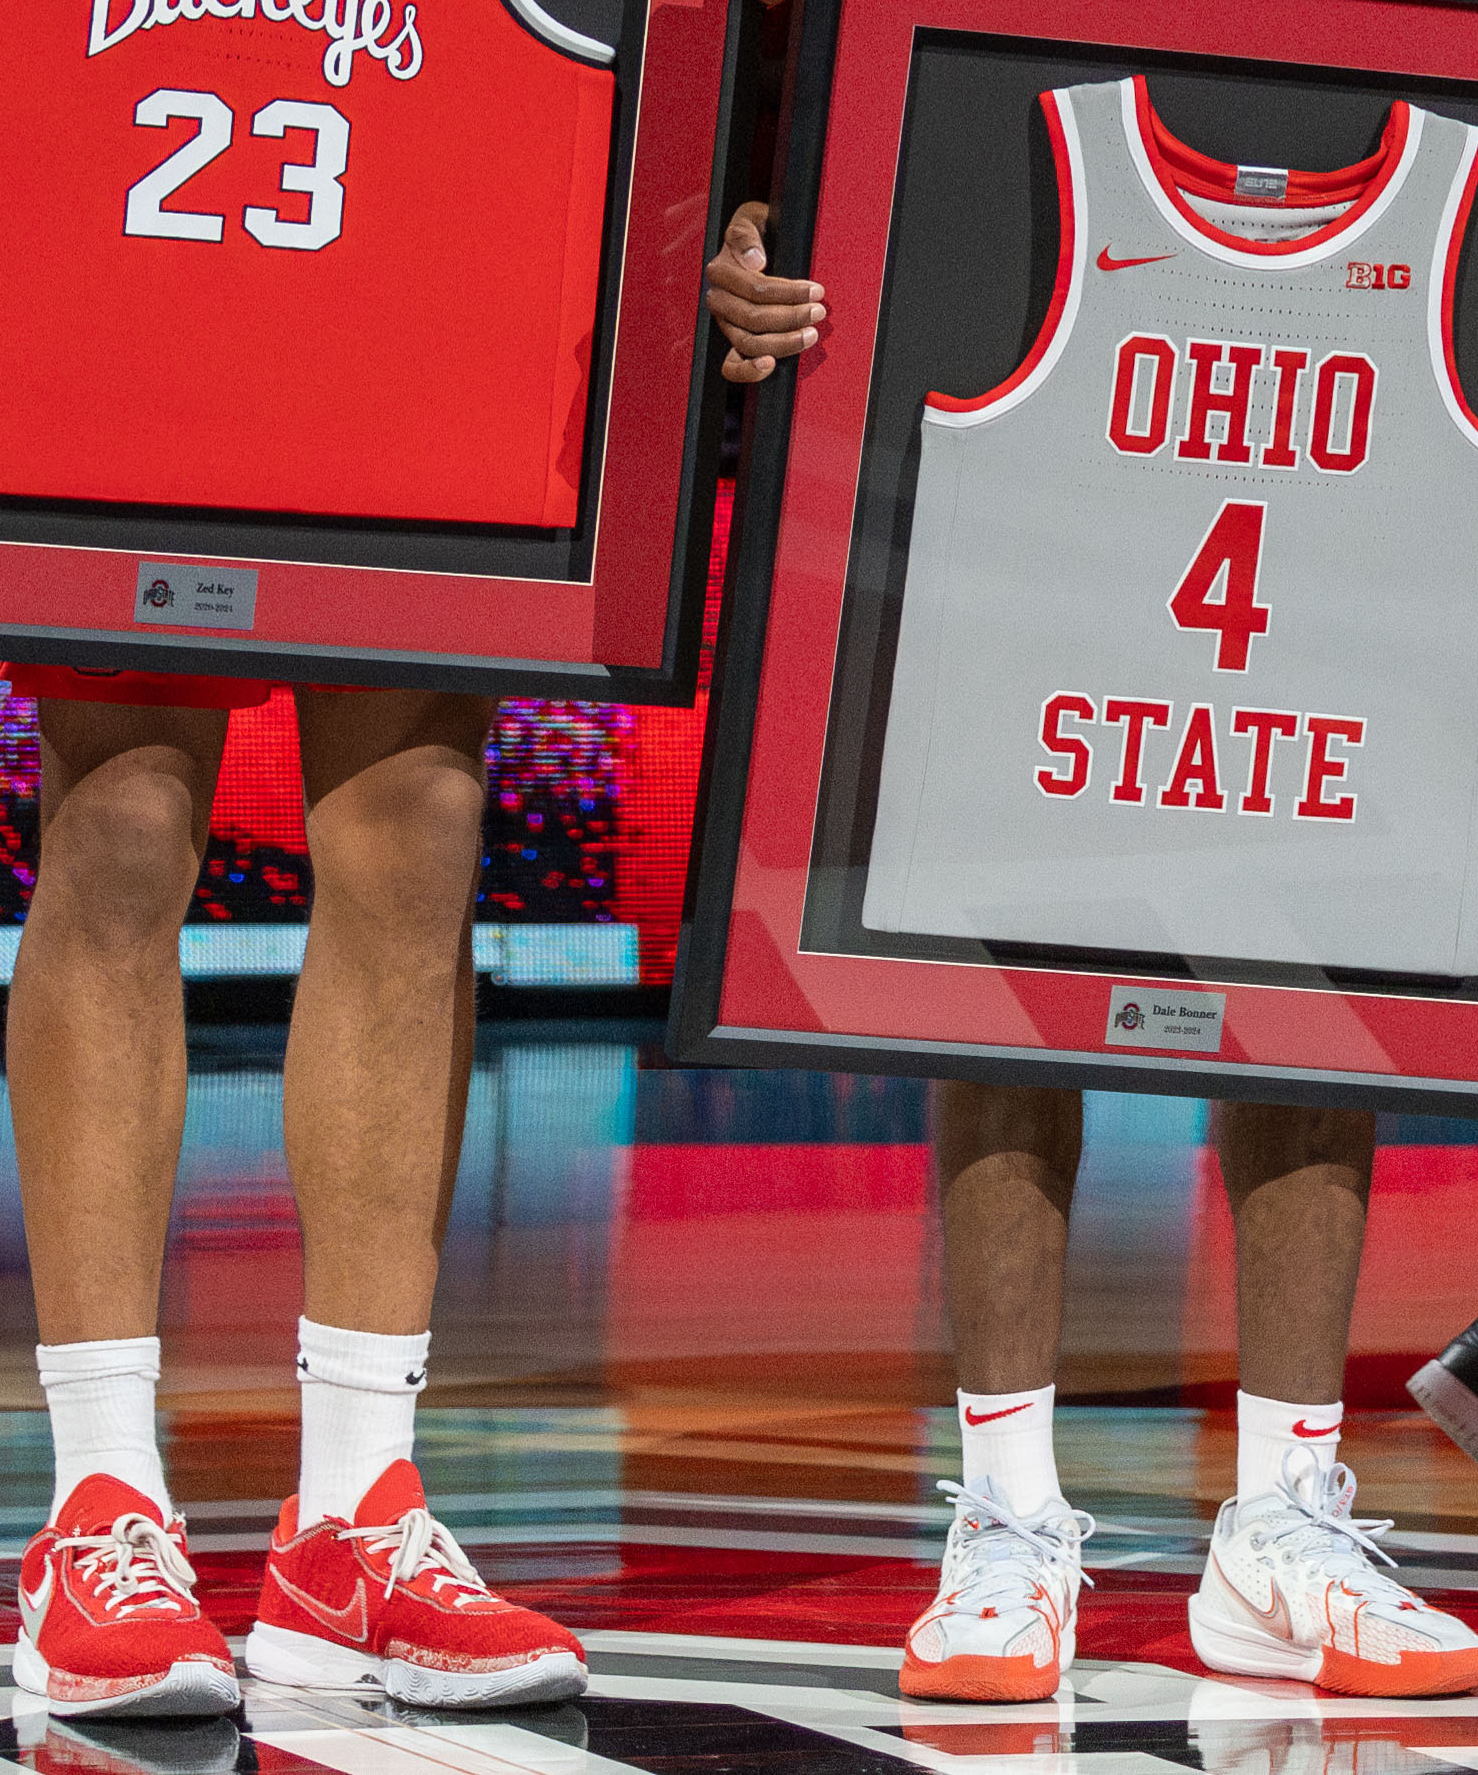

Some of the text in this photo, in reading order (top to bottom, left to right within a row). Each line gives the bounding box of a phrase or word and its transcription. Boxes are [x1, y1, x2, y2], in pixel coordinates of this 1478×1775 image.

[123, 88, 350, 251] 23
[1105, 330, 1378, 475] OHIO
[196, 583, 235, 598] Zed Key
[1166, 498, 1272, 674] 4
[1033, 690, 1368, 823] STATE
[1152, 1005, 1218, 1020] Dale Bonner
